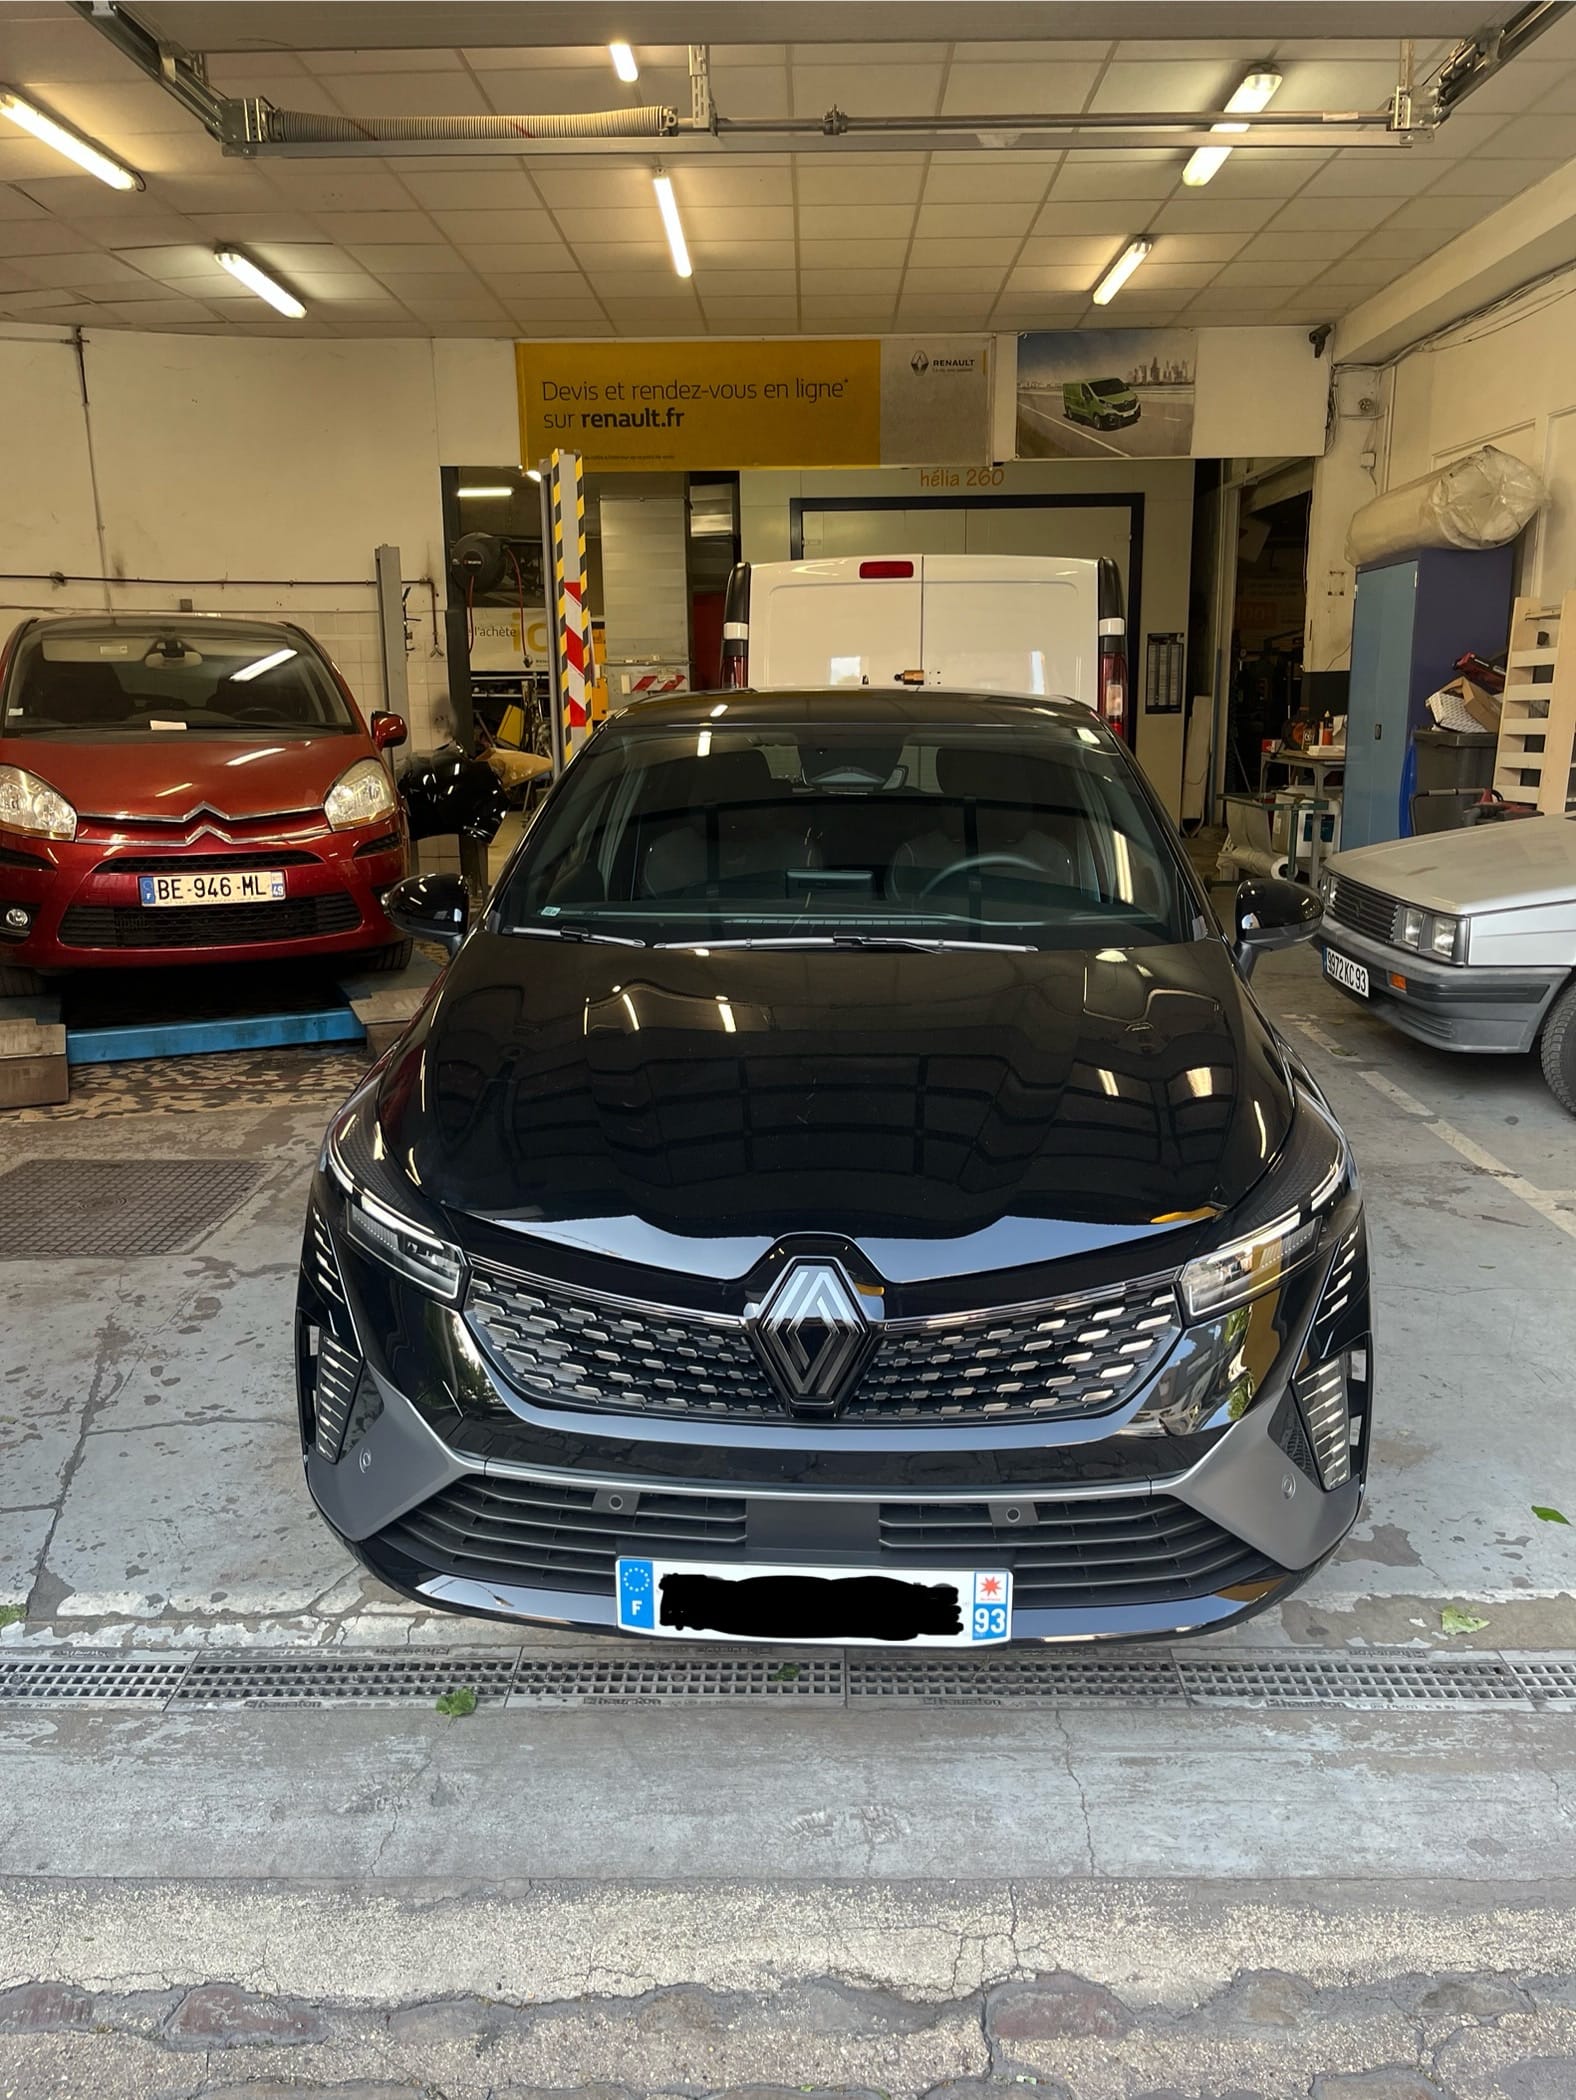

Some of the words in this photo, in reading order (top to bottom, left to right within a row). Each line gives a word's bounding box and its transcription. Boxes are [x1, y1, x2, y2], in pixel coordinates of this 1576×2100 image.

[932, 359, 976, 367] RENAULT
[542, 381, 599, 401] Devis
[604, 381, 625, 401] et
[632, 379, 757, 401] rendez-vous
[763, 383, 789, 399] en
[543, 413, 575, 429] sur
[581, 407, 685, 429] renault.fr
[920, 468, 960, 487] hélia
[966, 468, 1005, 487] 260
[474, 624, 517, 638] l'achète
[1344, 961, 1355, 987] KC
[1355, 968, 1366, 993] 93
[632, 1599, 643, 1616] F
[974, 1607, 1006, 1634] 93
